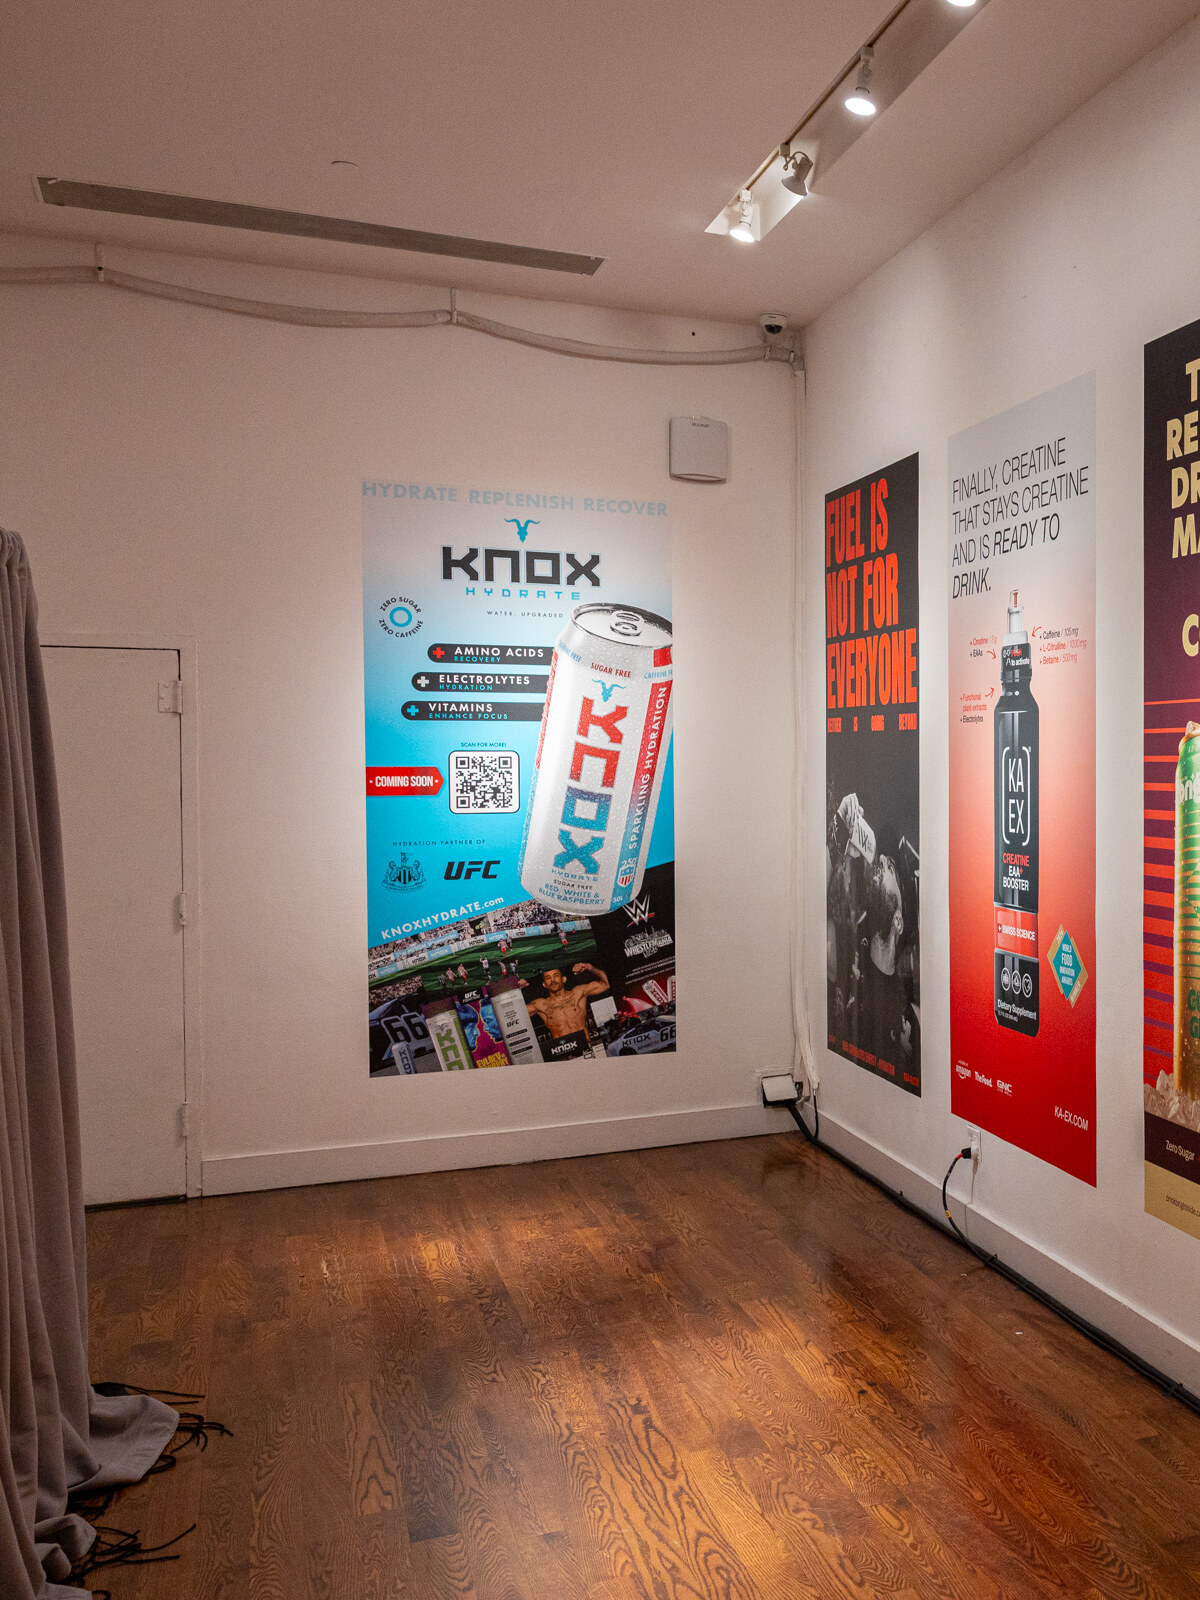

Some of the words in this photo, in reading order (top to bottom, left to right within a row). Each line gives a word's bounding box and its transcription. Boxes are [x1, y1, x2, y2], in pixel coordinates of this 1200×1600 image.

[952, 464, 998, 504] FINALLY,
[1002, 437, 1066, 486] CREATINE
[362, 481, 457, 502] HYDRATE
[469, 489, 575, 510] REPLENISH
[584, 498, 668, 516] RECOVER
[952, 504, 981, 535] THAT
[982, 491, 1020, 526] STAYS
[1021, 466, 1089, 513] CREATINE
[826, 489, 865, 568] FUEL
[870, 477, 889, 553] IS
[952, 539, 977, 567] AND
[979, 534, 990, 560] IS
[993, 519, 1038, 556] READY
[1041, 512, 1061, 543] TO
[442, 546, 600, 587] KNOX
[466, 587, 581, 600] HYDRATE
[826, 565, 857, 638] NOT
[863, 552, 899, 632] FOR
[952, 567, 992, 599] DRINK.
[380, 597, 397, 612] ZERO
[399, 596, 421, 613] SUGAR
[379, 618, 394, 635] ZERO
[395, 619, 423, 638] CAFFEINE
[455, 646, 500, 657] AMINO
[506, 648, 544, 658] ACIDS
[439, 674, 530, 685] ELECTROLYTES
[591, 662, 613, 675] SUGAR
[615, 669, 632, 678] FREE
[827, 627, 918, 709] EVERYONE
[429, 703, 493, 712] VITAMINS
[628, 773, 651, 850] SPARKLING
[643, 686, 668, 770] HYDRATION
[1008, 758, 1025, 793] KA
[375, 776, 409, 788] COMING
[410, 776, 434, 788] SOON
[553, 695, 629, 875] KNOX
[1008, 799, 1025, 834] EX
[444, 860, 501, 881] UFC
[1003, 852, 1030, 867] CREATINE
[563, 888, 592, 899] WHITE
[1003, 876, 1029, 891] BOOSTER
[538, 887, 556, 899] BLUE
[556, 893, 605, 905] RASPBERRY
[381, 897, 505, 940] KNOXHYDRATE.com
[1002, 924, 1016, 937] SWISS
[1016, 927, 1036, 942] SCIENCE
[1054, 1105, 1089, 1131] KA-EX.COM
[1165, 1139, 1178, 1154] Zero
[1178, 1144, 1195, 1162] Sugar
